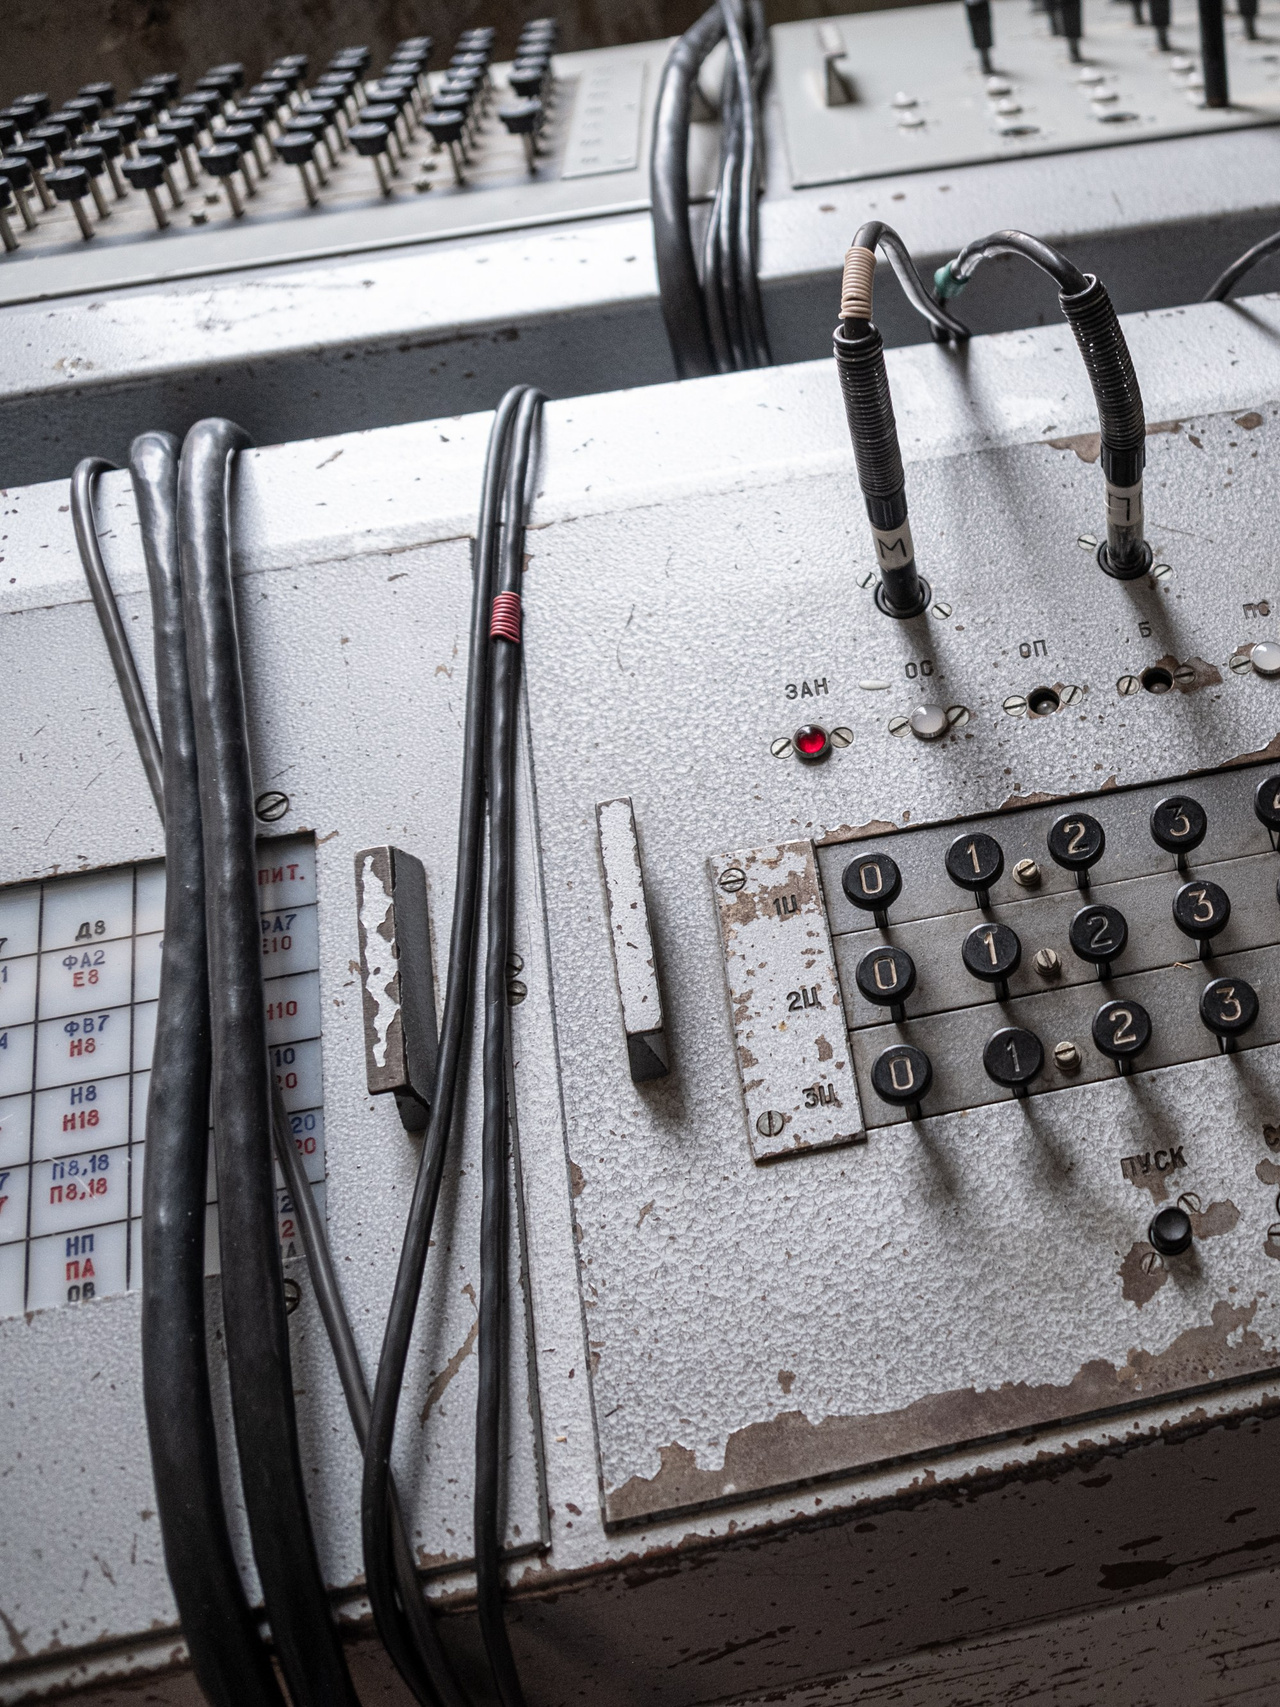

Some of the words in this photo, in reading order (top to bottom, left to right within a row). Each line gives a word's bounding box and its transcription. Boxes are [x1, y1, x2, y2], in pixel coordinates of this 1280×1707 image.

[1138, 620, 1153, 638] Б
[1169, 804, 1190, 837] 3
[1064, 822, 1089, 854] 2
[966, 842, 981, 874] 1
[860, 863, 882, 895] 0
[1190, 889, 1214, 923] 3
[75, 920, 106, 942] Д8
[1087, 915, 1112, 948] 2
[62, 949, 106, 970] ФА2
[978, 932, 999, 966] 1
[73, 969, 99, 988] Е8
[874, 958, 897, 989] 0
[786, 986, 822, 1012] 2Ц
[1216, 986, 1241, 1021] 3
[64, 1014, 110, 1037] ФВ7
[1109, 1009, 1137, 1046] 2
[69, 1037, 96, 1057] Н8
[1005, 1039, 1020, 1073] 1
[889, 1057, 914, 1091] 0
[70, 1085, 98, 1105] Н8
[62, 1109, 100, 1132] Н18
[52, 1154, 110, 1181] П8,18
[1120, 1145, 1188, 1179] ПУСК
[50, 1177, 108, 1204] П8,18
[66, 1233, 95, 1257] НП
[66, 1258, 96, 1281] ПА
